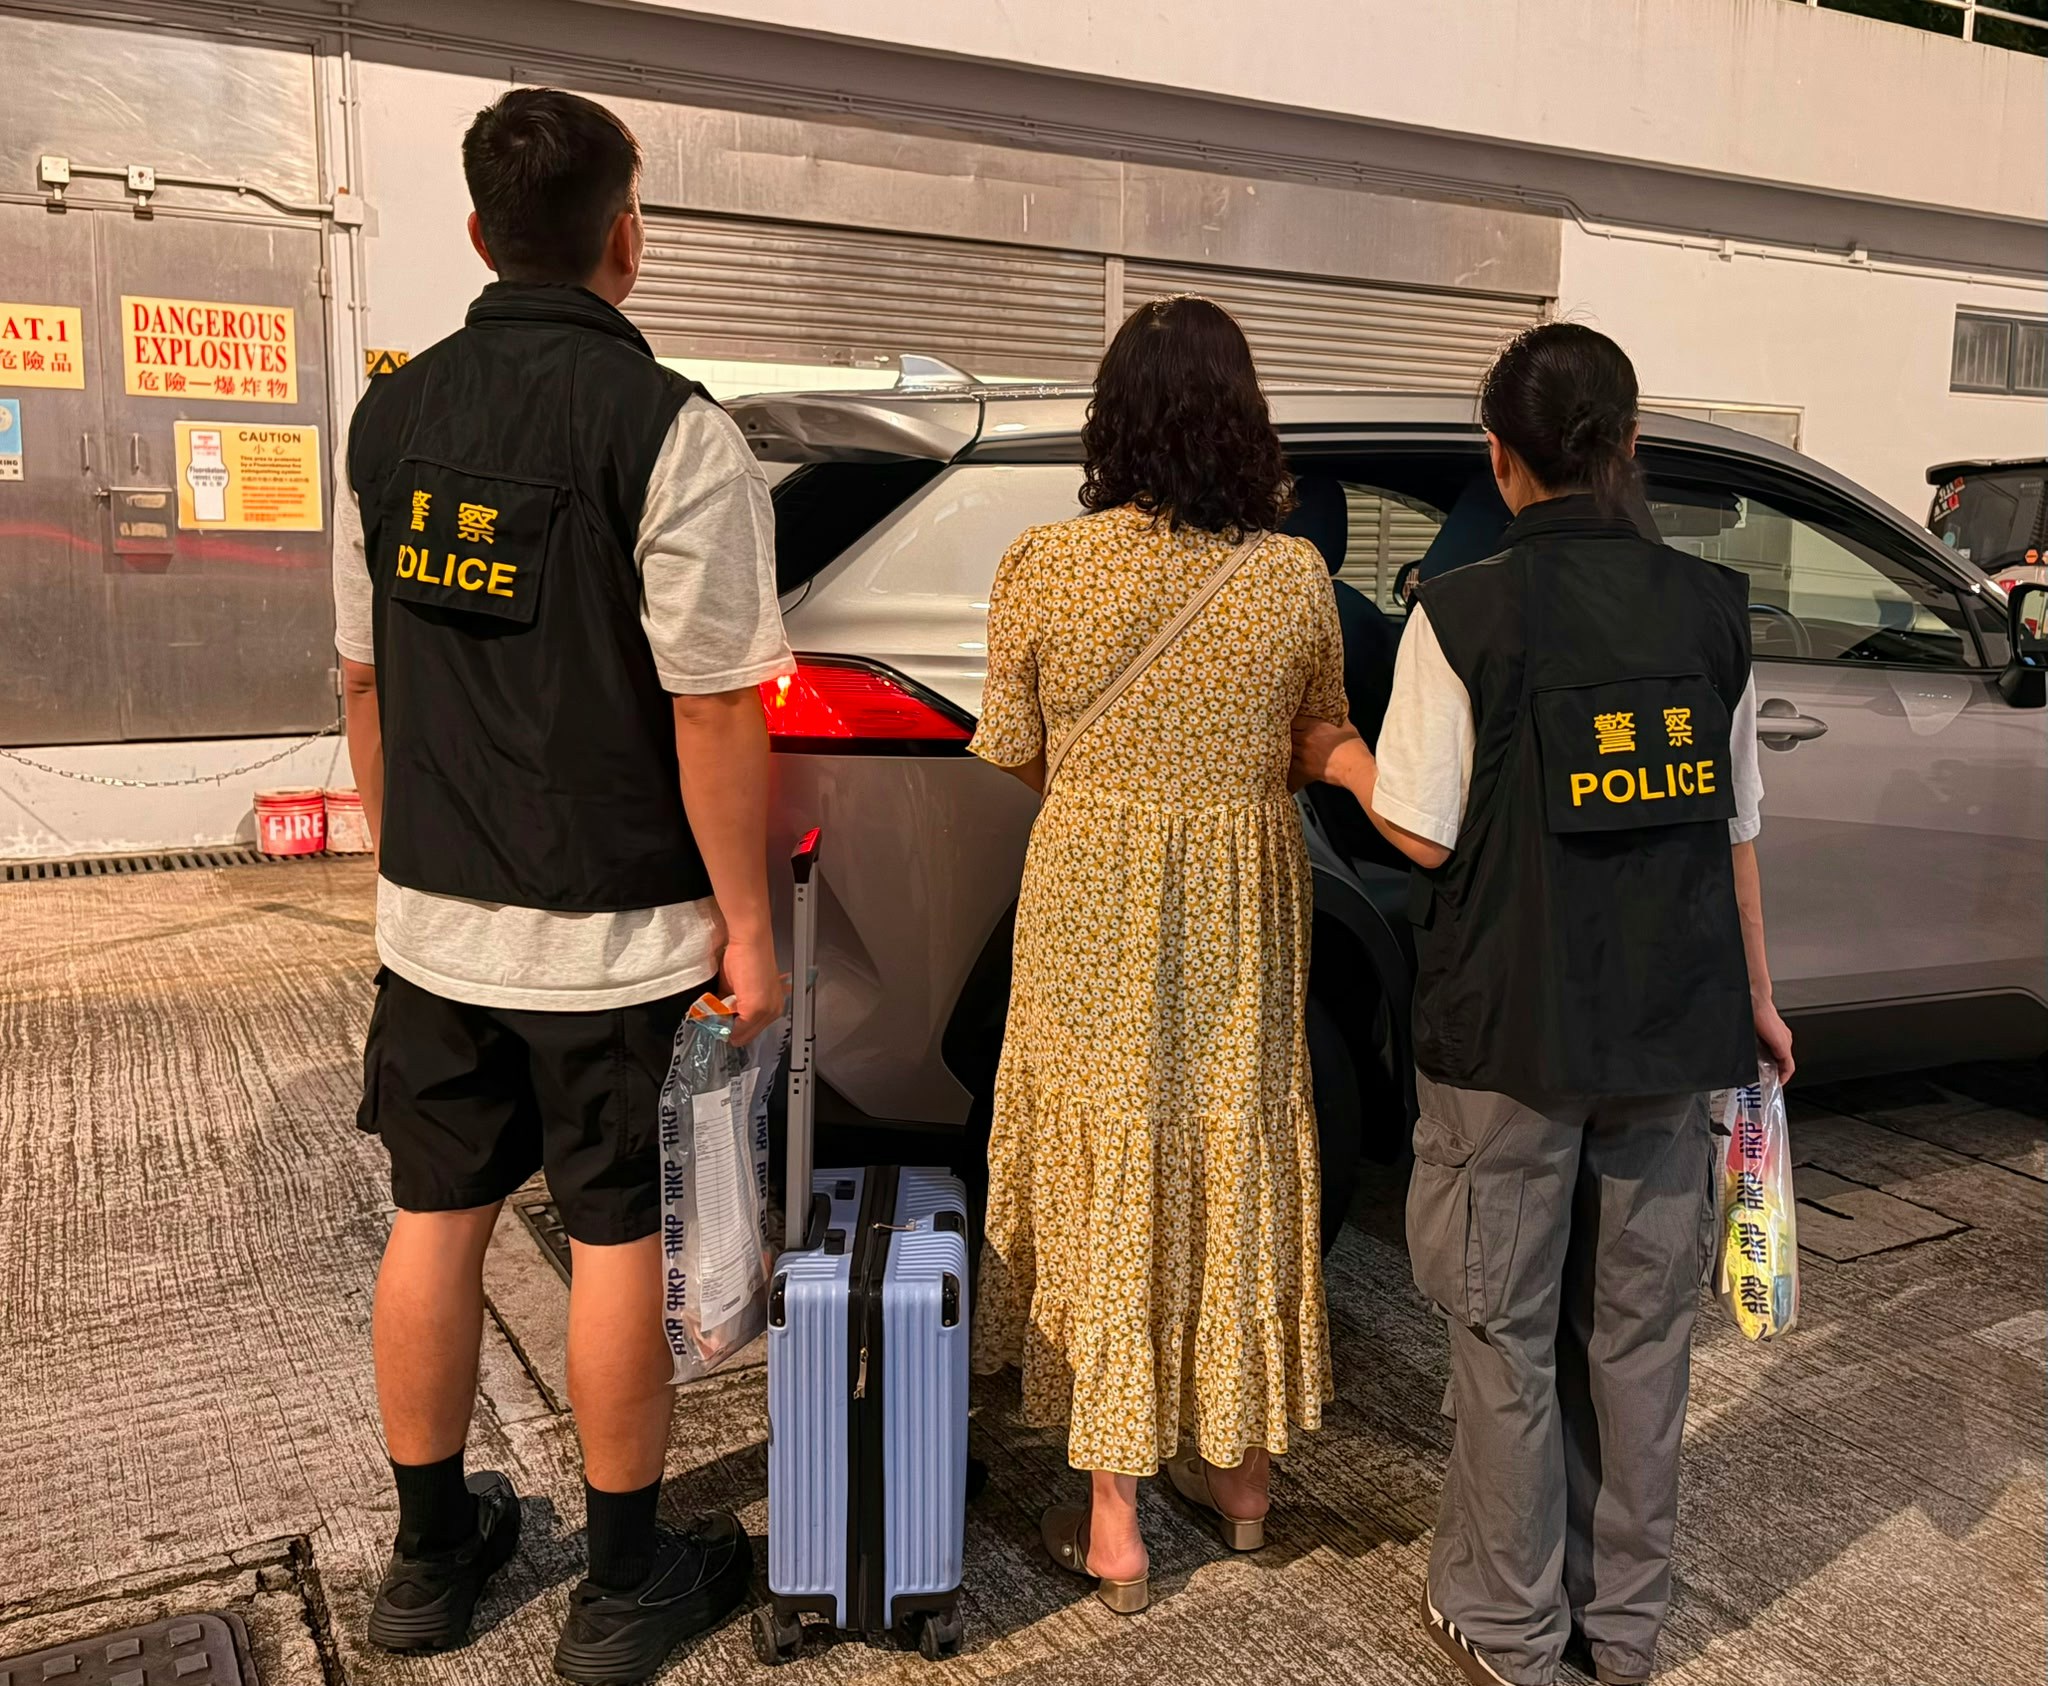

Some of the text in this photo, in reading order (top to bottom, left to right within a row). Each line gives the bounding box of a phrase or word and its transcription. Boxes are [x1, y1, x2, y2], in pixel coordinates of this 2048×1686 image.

[132, 303, 287, 342] DANGEROUS
[135, 336, 288, 374] EXPLOSIVES
[239, 432, 301, 443] CAUTION
[1593, 706, 1694, 755] 警察
[1570, 759, 1716, 807] POLICE
[268, 812, 324, 841] FIRE
